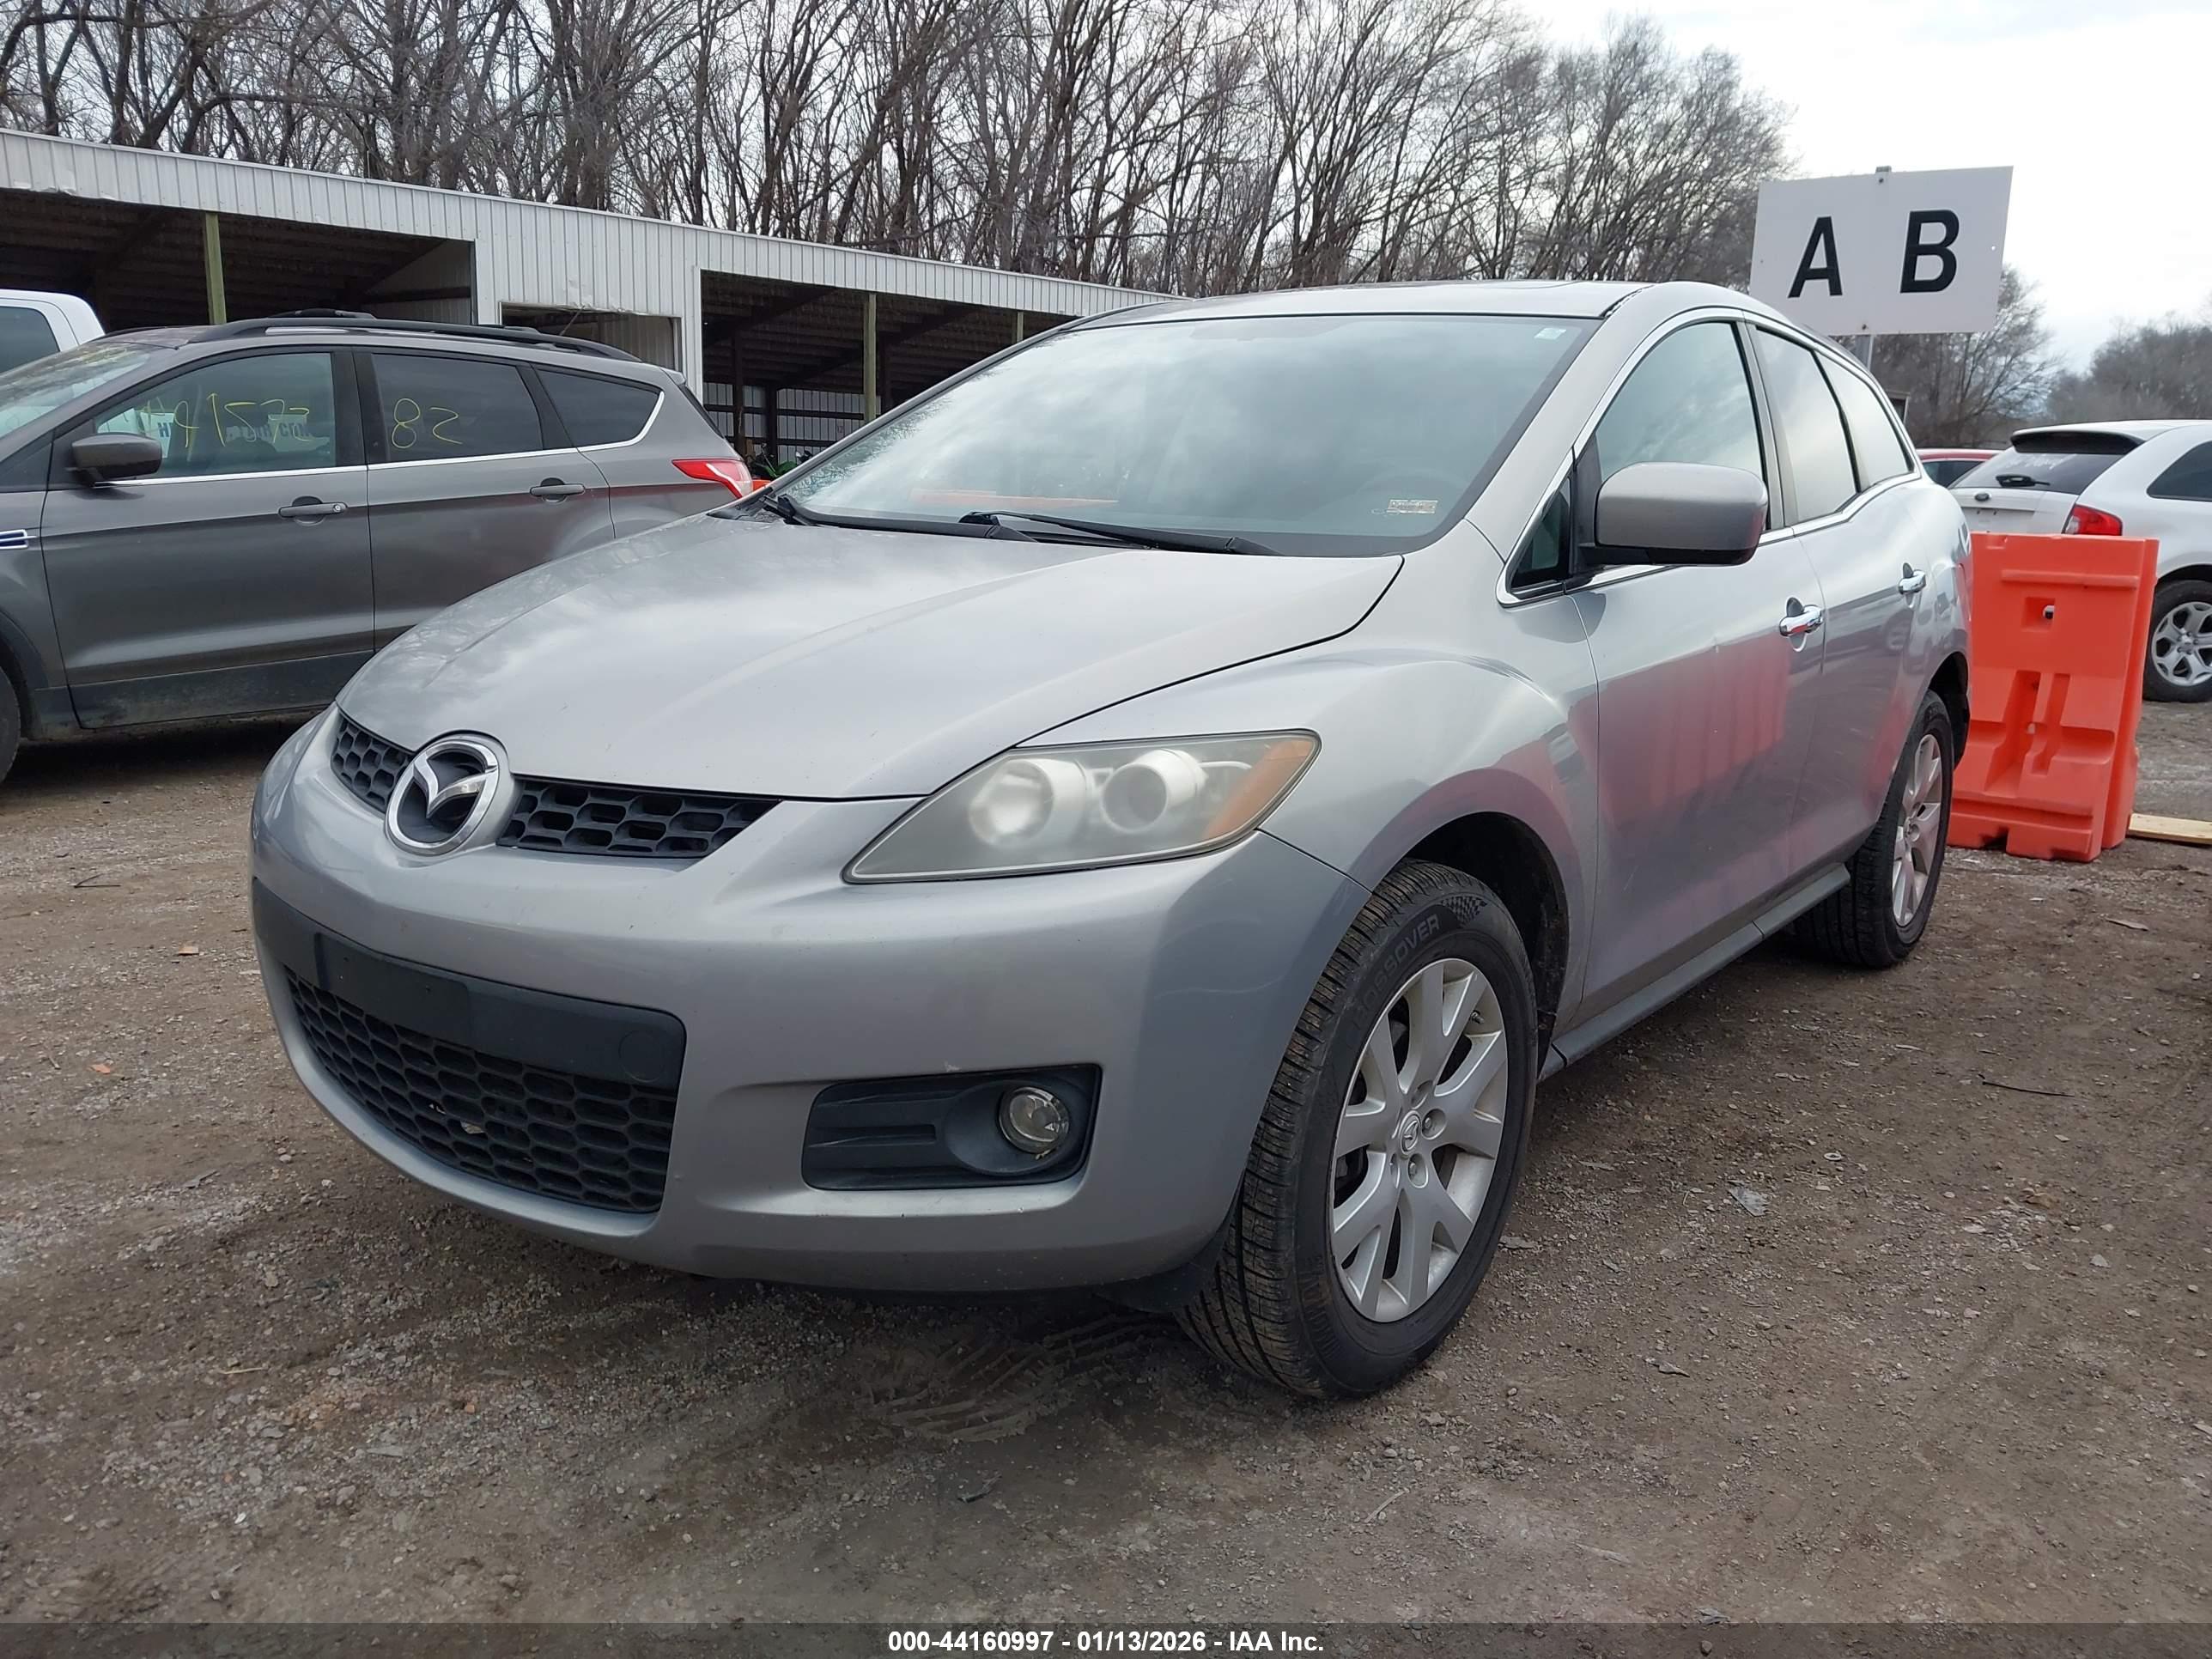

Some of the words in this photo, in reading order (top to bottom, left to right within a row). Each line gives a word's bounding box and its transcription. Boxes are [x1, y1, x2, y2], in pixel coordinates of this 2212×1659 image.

[1789, 216, 1844, 298] A
[1900, 209, 1960, 294] B
[1346, 913, 1441, 1042] ROSSOVER
